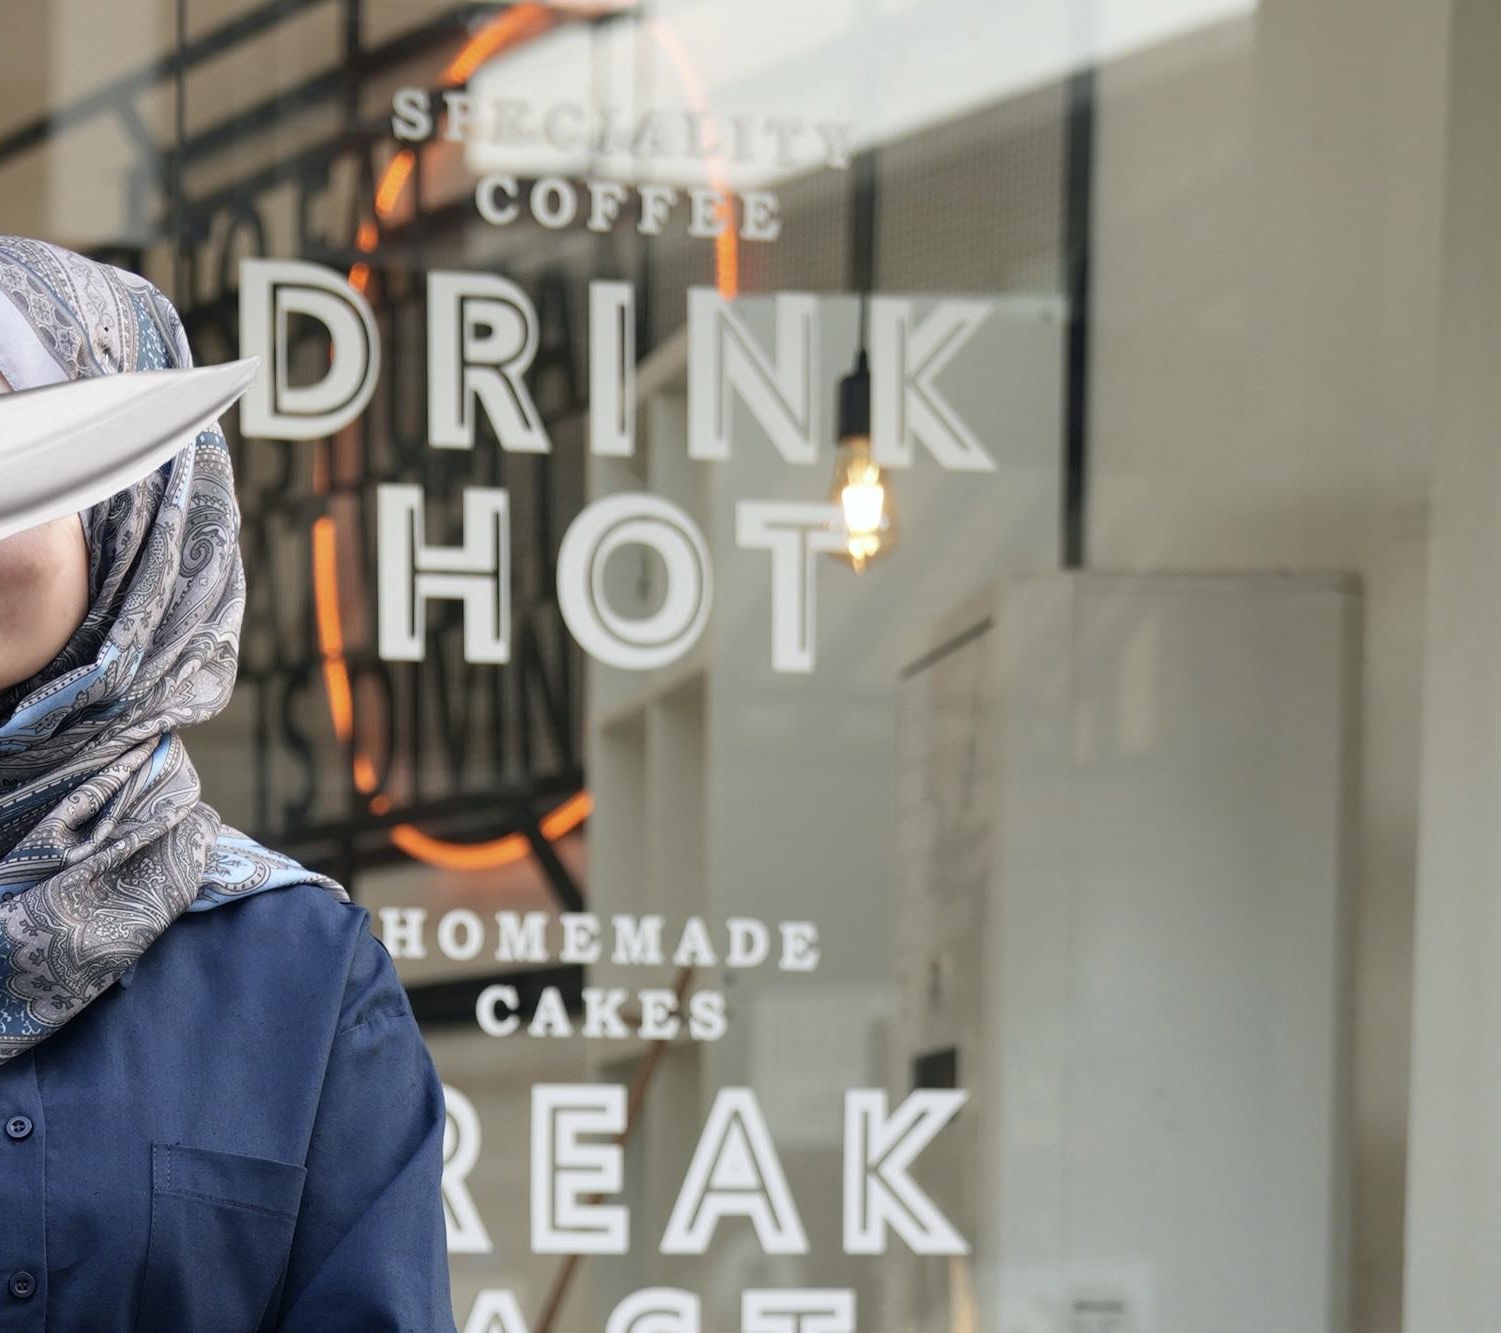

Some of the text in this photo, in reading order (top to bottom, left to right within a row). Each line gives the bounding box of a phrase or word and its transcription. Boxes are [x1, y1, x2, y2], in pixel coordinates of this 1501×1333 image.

[391, 87, 860, 170] SPECIALITY
[474, 176, 784, 242] COFFEE
[238, 258, 998, 473] DRINK
[376, 483, 850, 675] HOT
[380, 908, 820, 972] HOMEMADE
[475, 986, 728, 1041] CAKES
[441, 1083, 971, 1256] EAK
